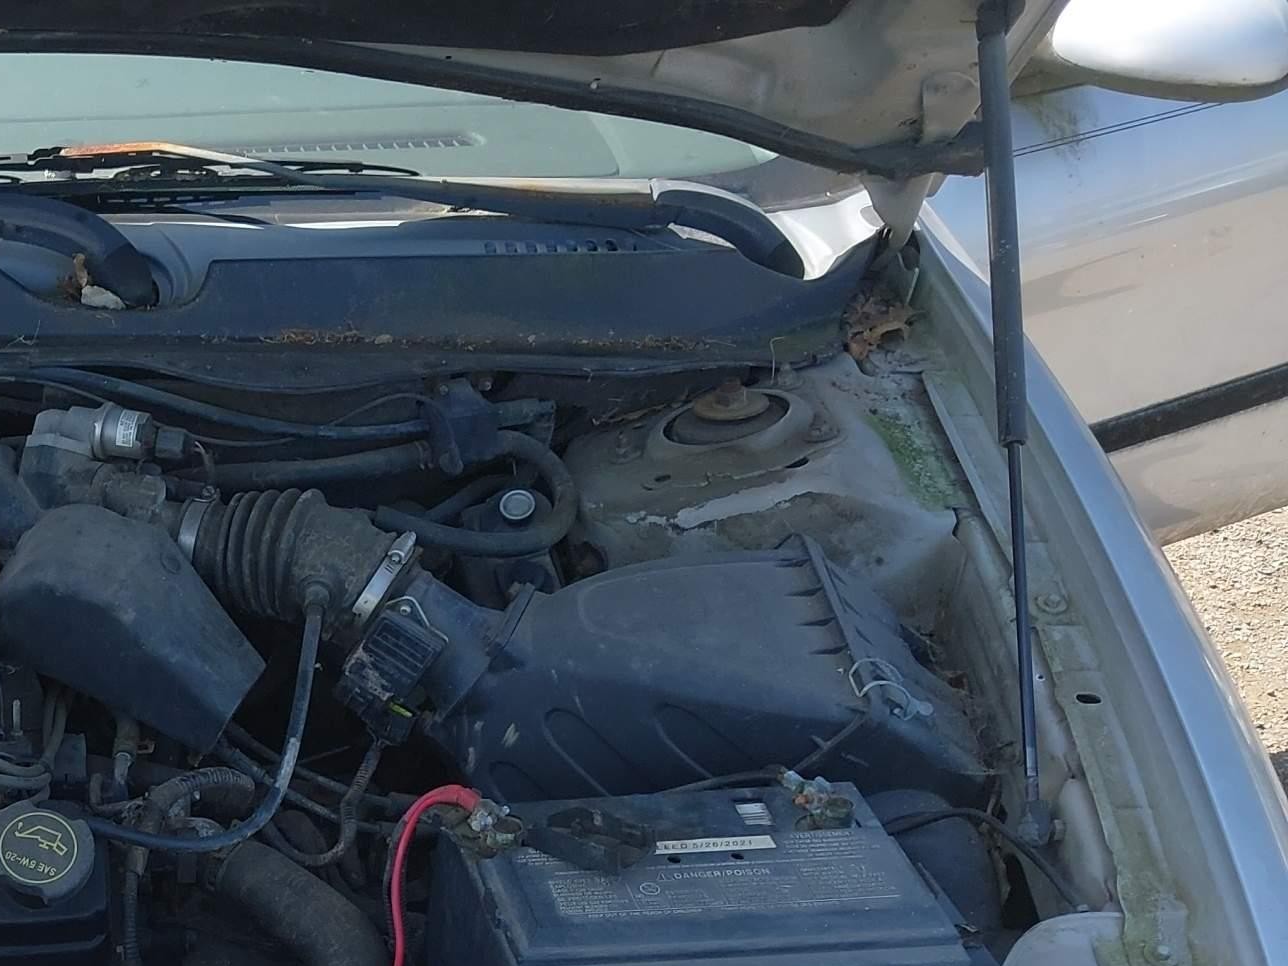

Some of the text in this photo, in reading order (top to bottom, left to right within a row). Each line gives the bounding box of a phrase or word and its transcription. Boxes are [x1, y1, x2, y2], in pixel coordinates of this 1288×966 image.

[4, 849, 57, 877] SAE 5W-20
[673, 867, 771, 880] DANGER/POISON
